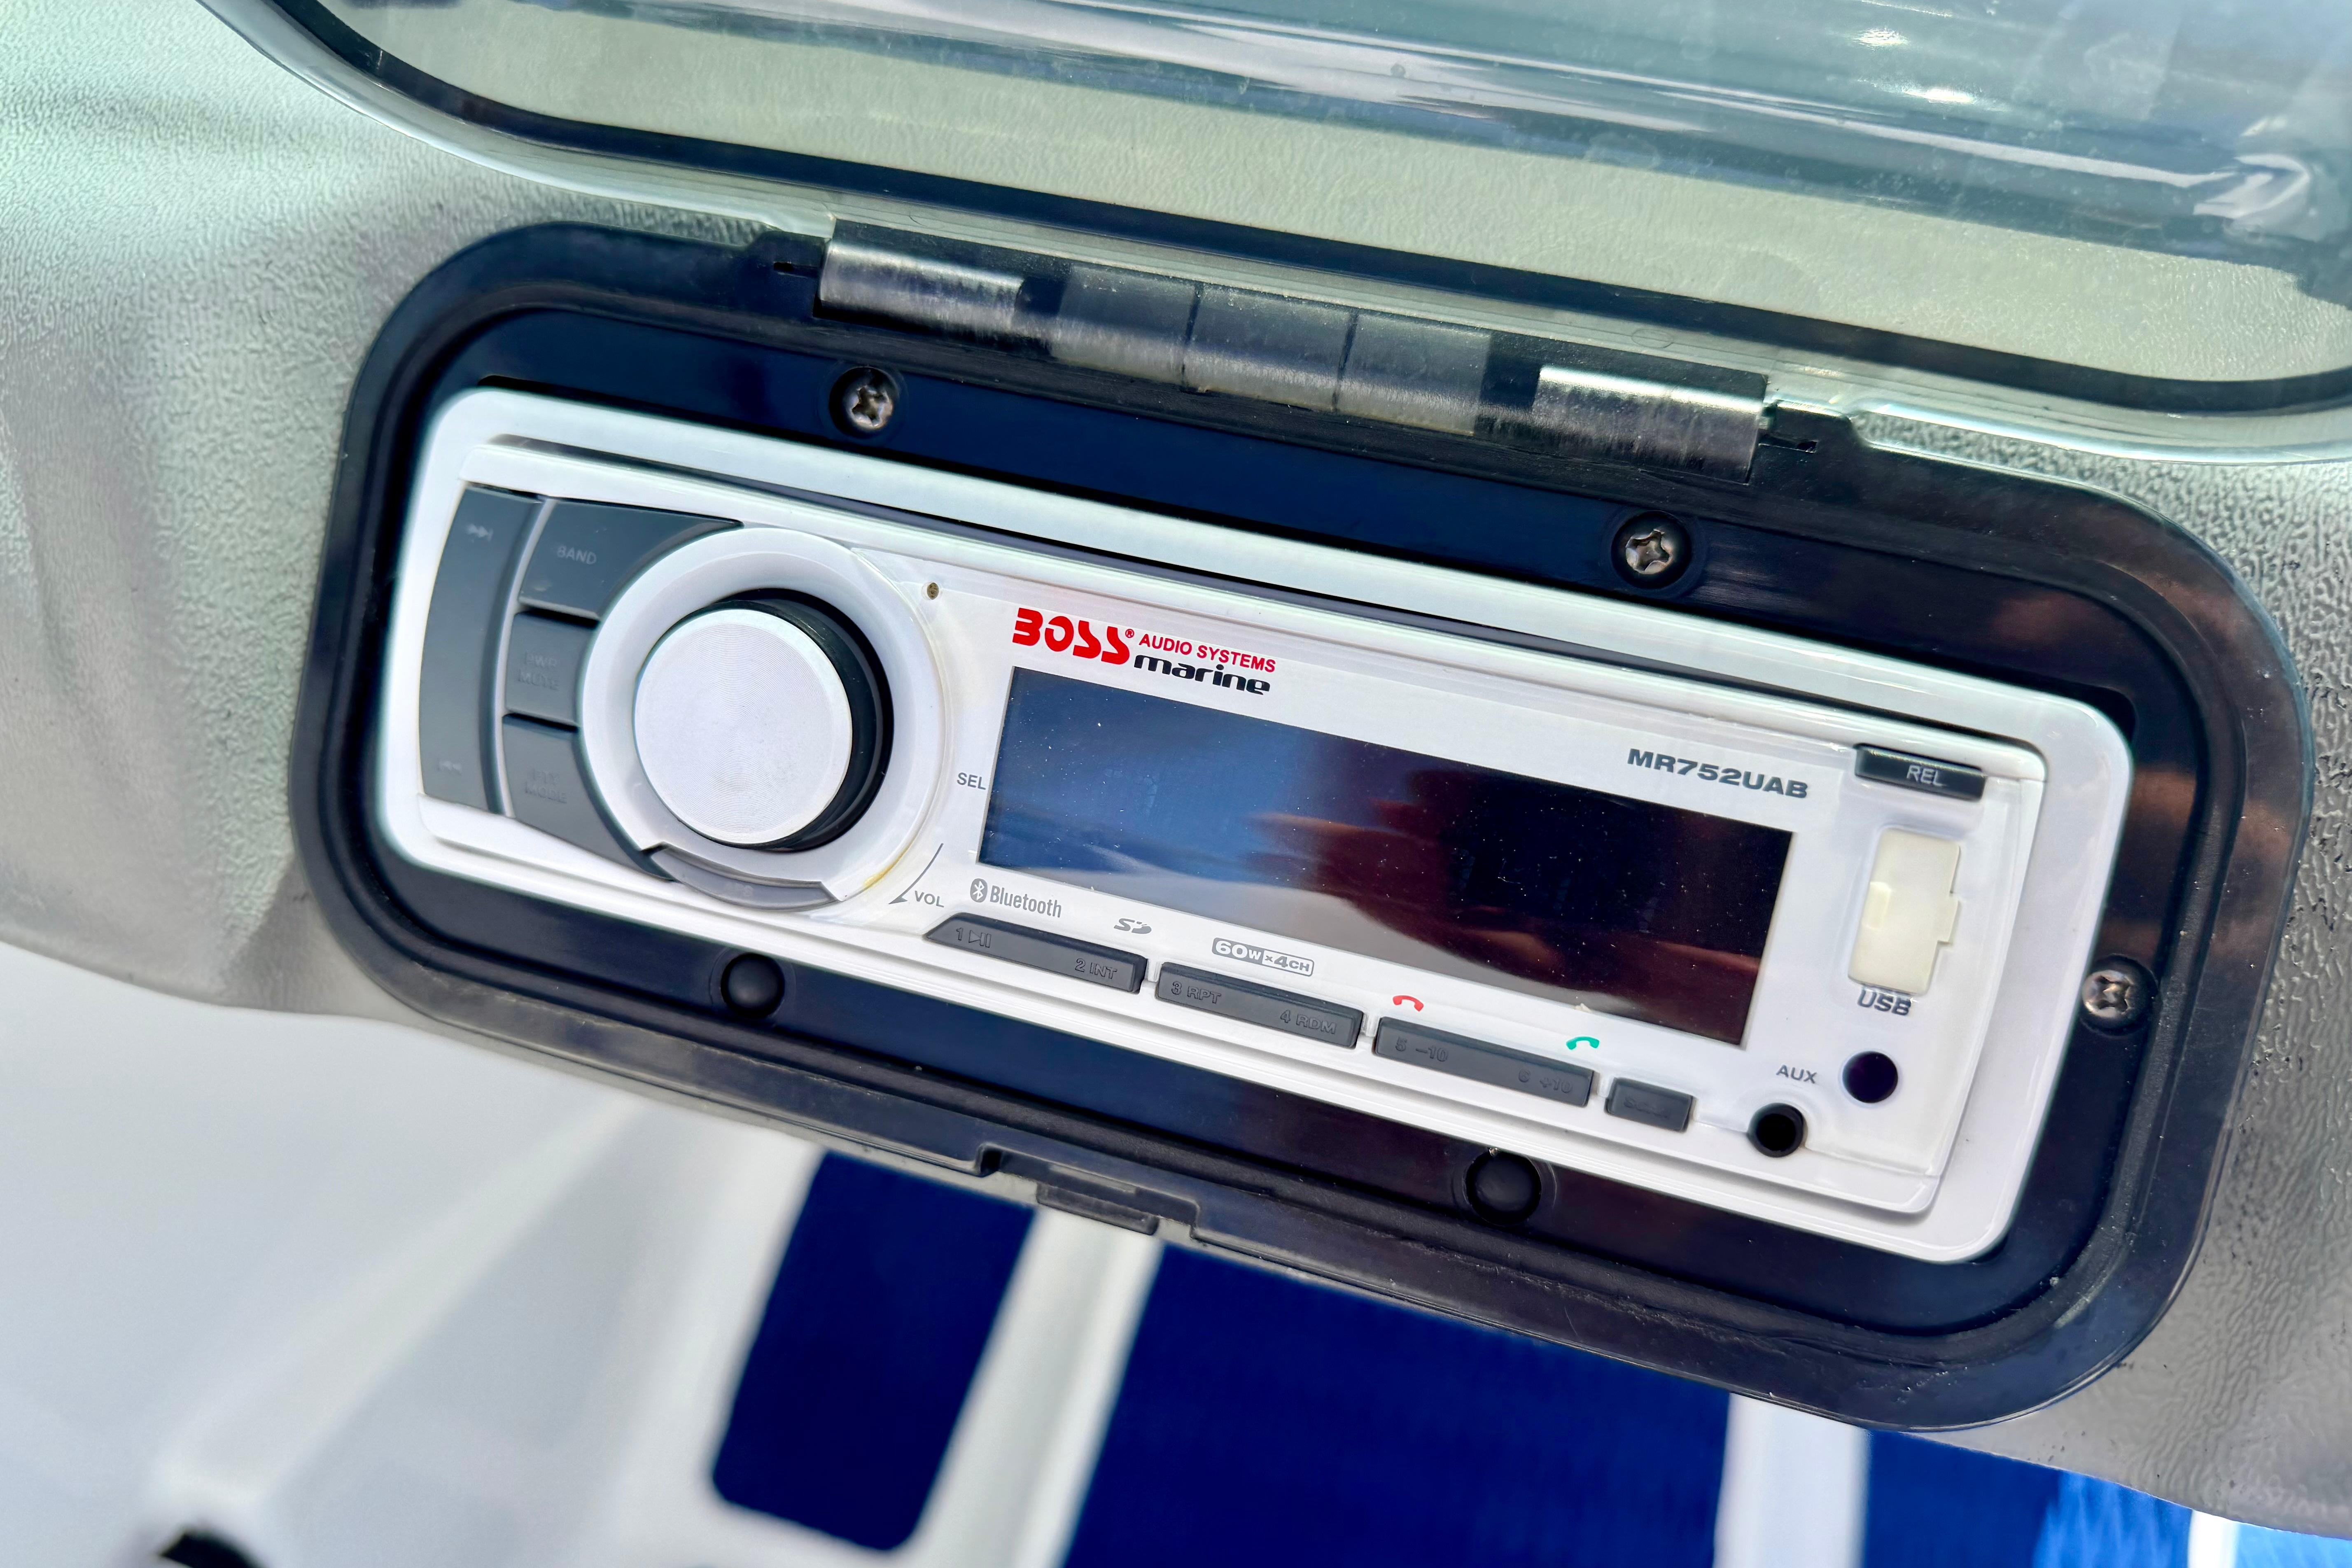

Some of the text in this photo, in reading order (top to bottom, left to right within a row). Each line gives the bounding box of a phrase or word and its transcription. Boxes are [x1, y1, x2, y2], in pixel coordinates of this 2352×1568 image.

[556, 545, 597, 565] BAND
[1139, 634, 1192, 656] AUDIO
[1197, 645, 1276, 673] SYSTEMS
[1134, 655, 1270, 695] marine
[957, 772, 986, 790] SEL
[1627, 748, 1808, 799] MR752UAB
[1906, 765, 1945, 786] REL
[914, 890, 944, 908] VOL
[990, 885, 1062, 918] Bluetooth
[1075, 958, 1117, 979] 2 INT
[1171, 981, 1221, 1003] 3 RPT
[1857, 988, 1911, 1016] USB
[1280, 1010, 1337, 1034] 4 RDM
[1395, 1037, 1407, 1052] 5
[1776, 1064, 1817, 1084] AUX
